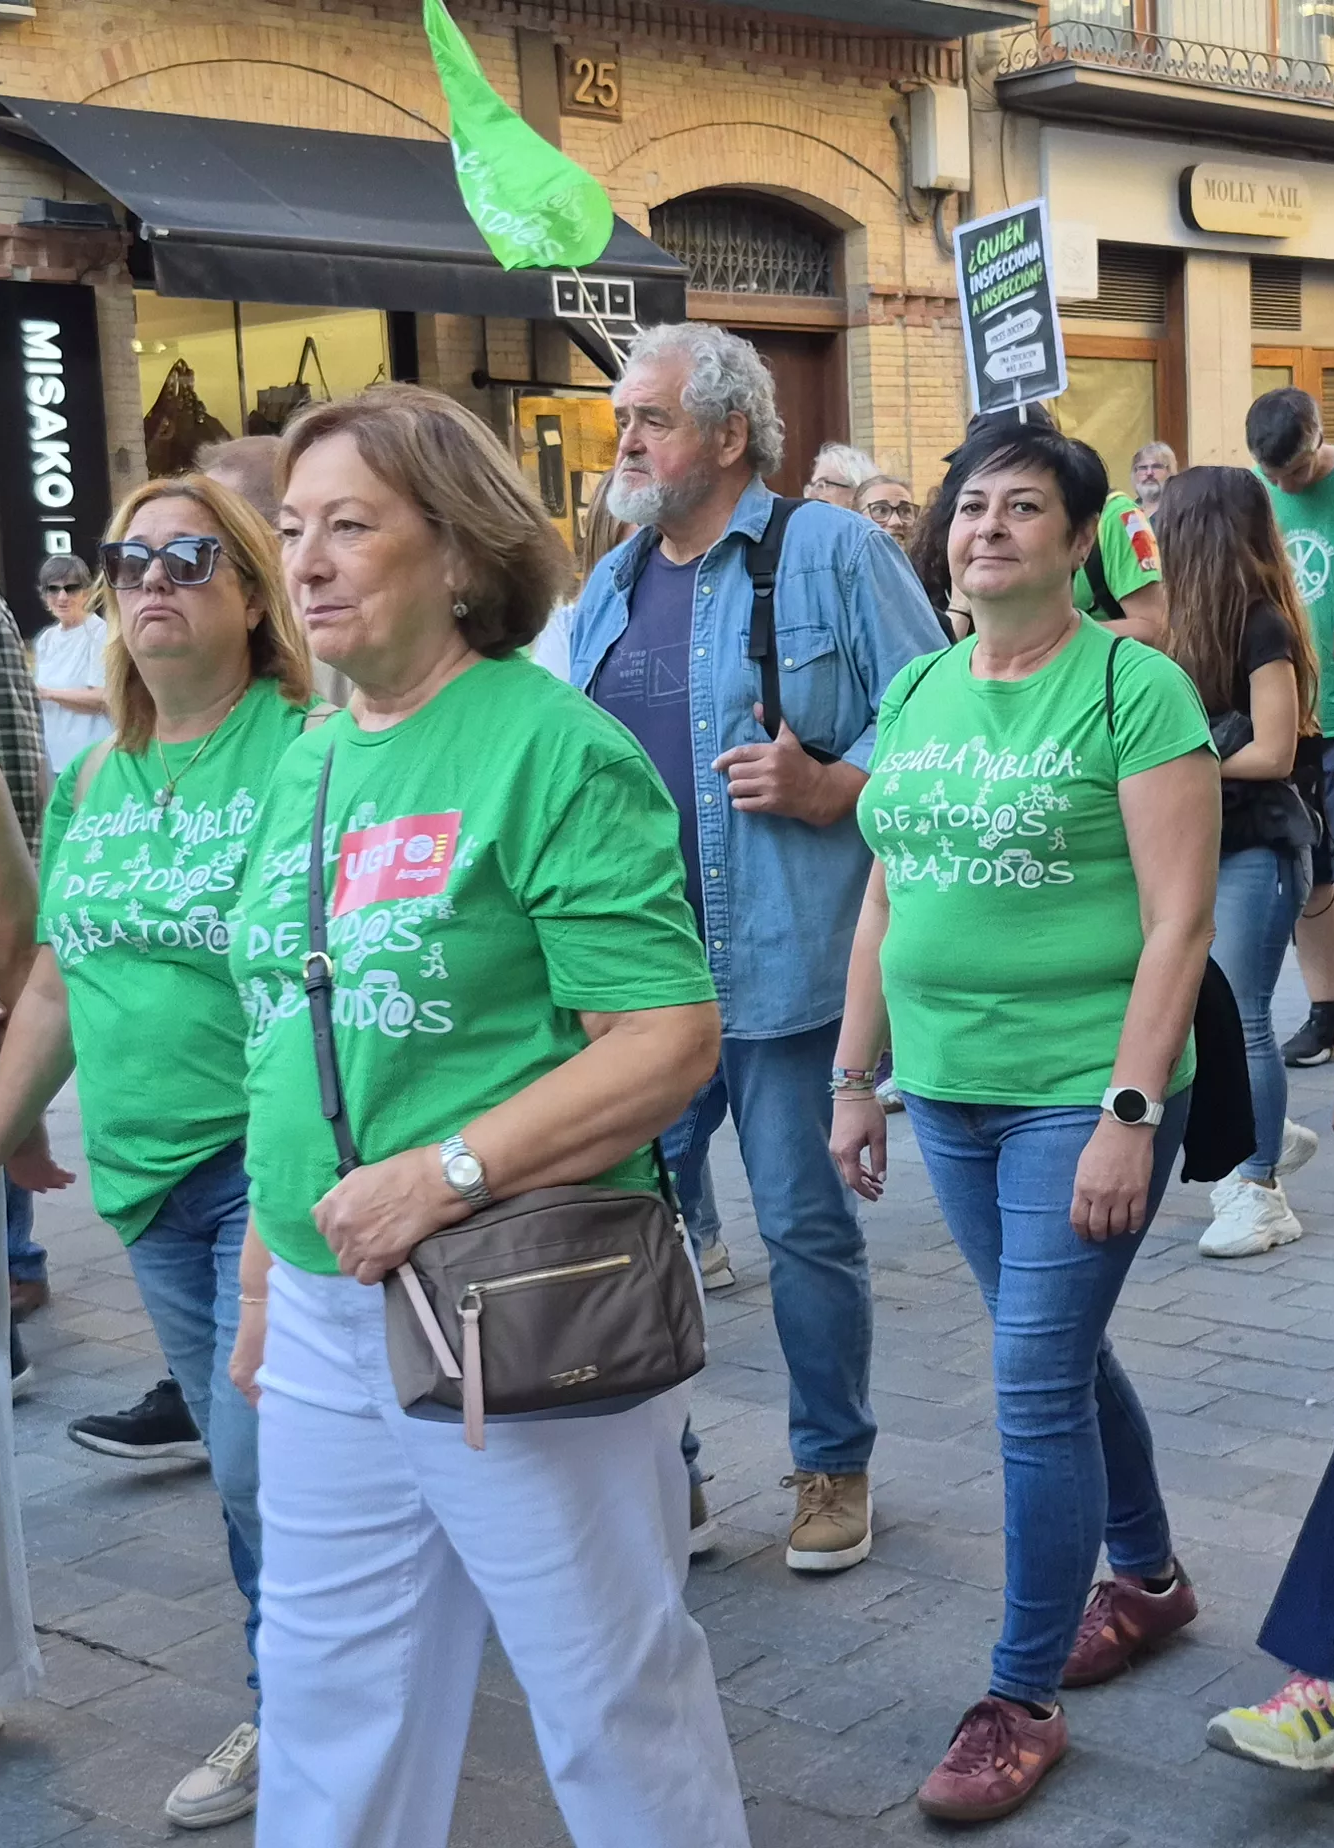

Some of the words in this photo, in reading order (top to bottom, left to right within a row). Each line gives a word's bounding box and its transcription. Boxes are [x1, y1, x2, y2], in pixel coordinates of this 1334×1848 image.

[575, 58, 618, 108] 25
[1204, 177, 1257, 205] MOLLY
[1266, 184, 1303, 209] NAIL
[968, 215, 1025, 274] ¿QUIÉN
[969, 240, 1041, 296] INSPECCIONA
[972, 299, 980, 318] A
[980, 261, 1044, 312] INSPECCIÓN?
[20, 318, 74, 508] MISAKO
[874, 742, 967, 775] ESCUELA
[972, 747, 1083, 782] PÚBLICA:
[68, 802, 164, 841] ESCUELA
[873, 804, 912, 835] DE
[928, 801, 1048, 840] TOD@S
[345, 838, 404, 881] UGT
[395, 867, 442, 882] Aragón
[949, 855, 1075, 889] TOD@S
[63, 870, 112, 900] DE
[126, 863, 236, 898] TOD@S
[51, 917, 133, 962] PARA
[245, 921, 305, 961] DE
